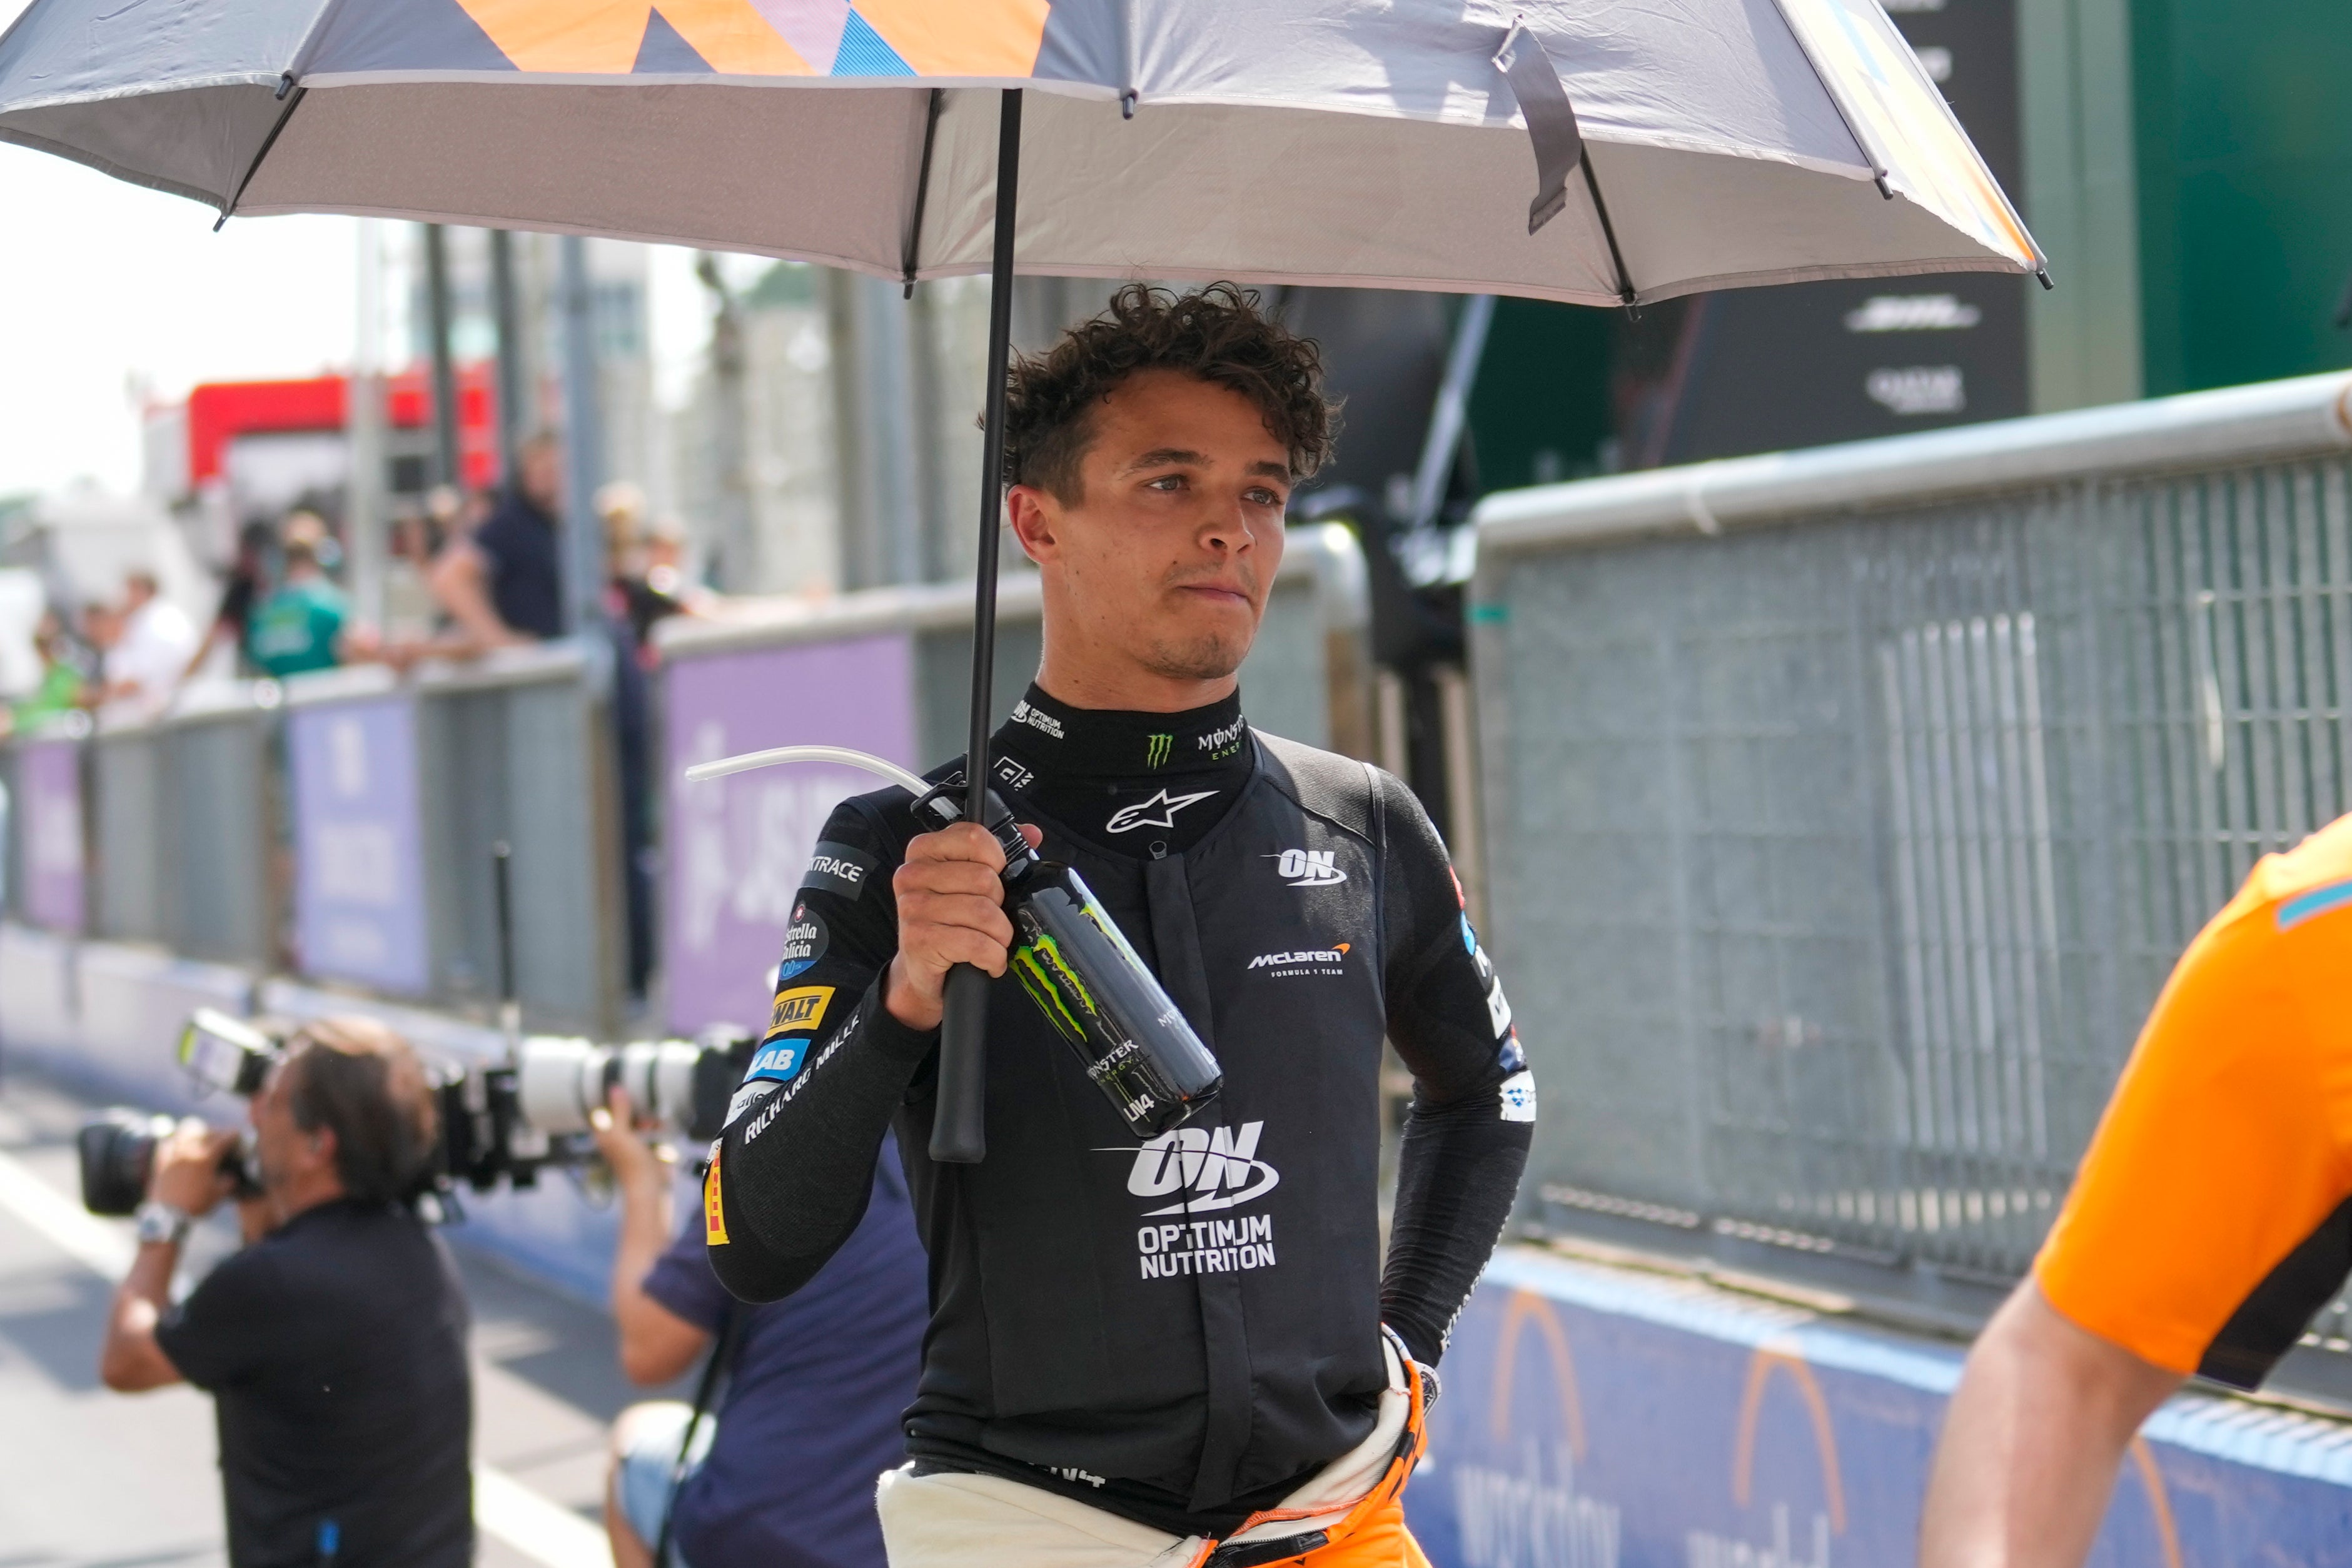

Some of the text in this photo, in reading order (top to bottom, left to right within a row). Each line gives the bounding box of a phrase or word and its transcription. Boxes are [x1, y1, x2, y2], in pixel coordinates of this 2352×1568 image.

[1027, 716, 1064, 739] NUTRITION
[1031, 708, 1061, 729] OPTIMUM
[1278, 849, 1345, 883] ON
[1247, 950, 1342, 970] McLaren
[1271, 969, 1310, 978] FORMULA
[770, 998, 820, 1026] WALT
[1086, 1040, 1139, 1080] ONSTER
[1124, 1094, 1154, 1122] LN4
[1128, 1120, 1279, 1217] ON
